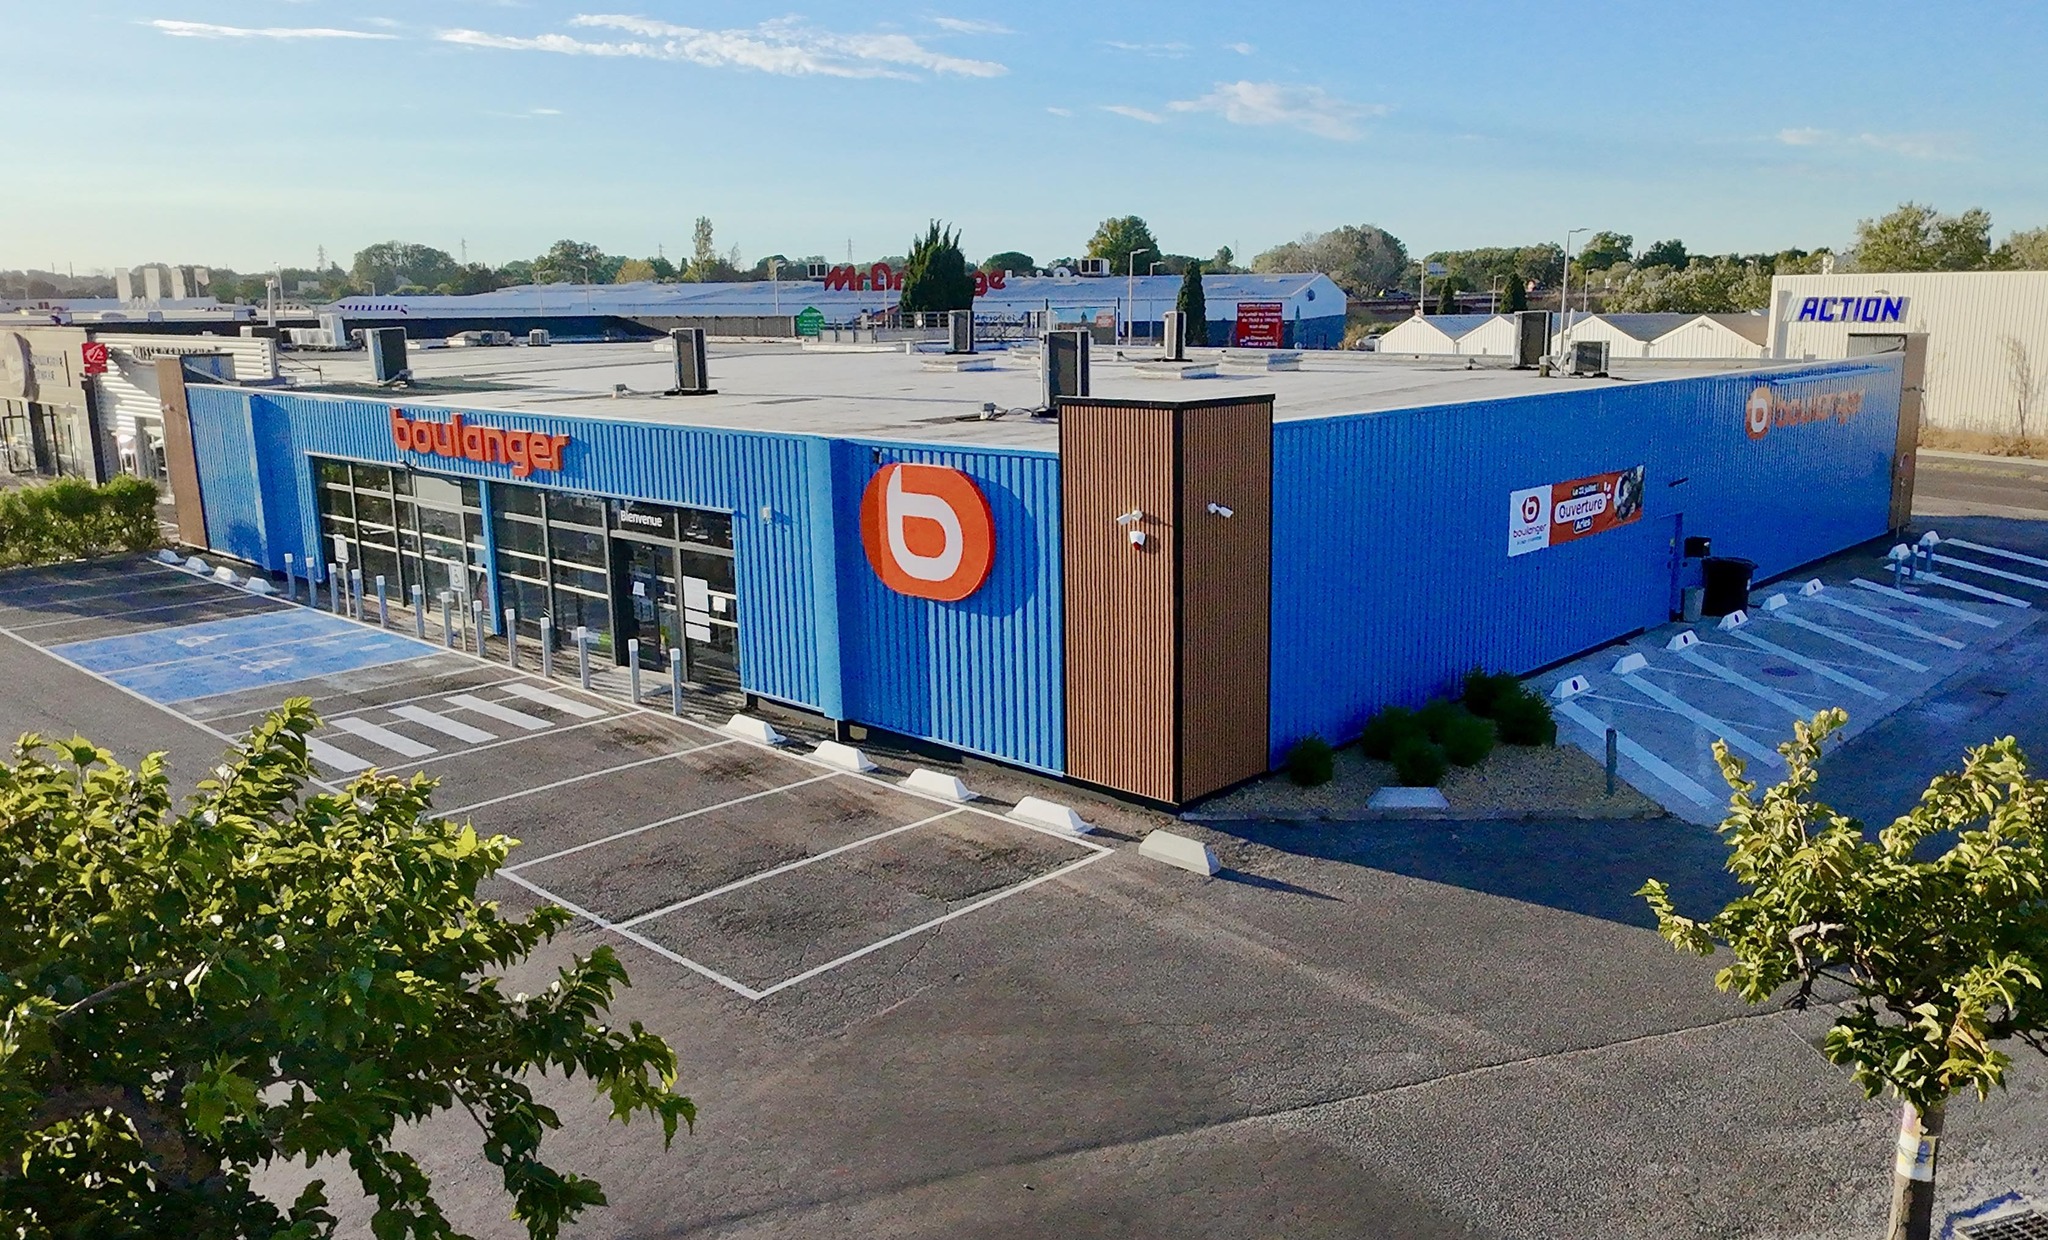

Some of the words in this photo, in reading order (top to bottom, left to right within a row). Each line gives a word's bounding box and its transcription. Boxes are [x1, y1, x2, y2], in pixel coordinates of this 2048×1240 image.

[1798, 297, 1904, 322] ACTION
[390, 407, 570, 478] boulanger
[620, 510, 663, 528] Bienvenue
[1559, 498, 1603, 519] Ouverture
[1513, 523, 1547, 538] boulanger
